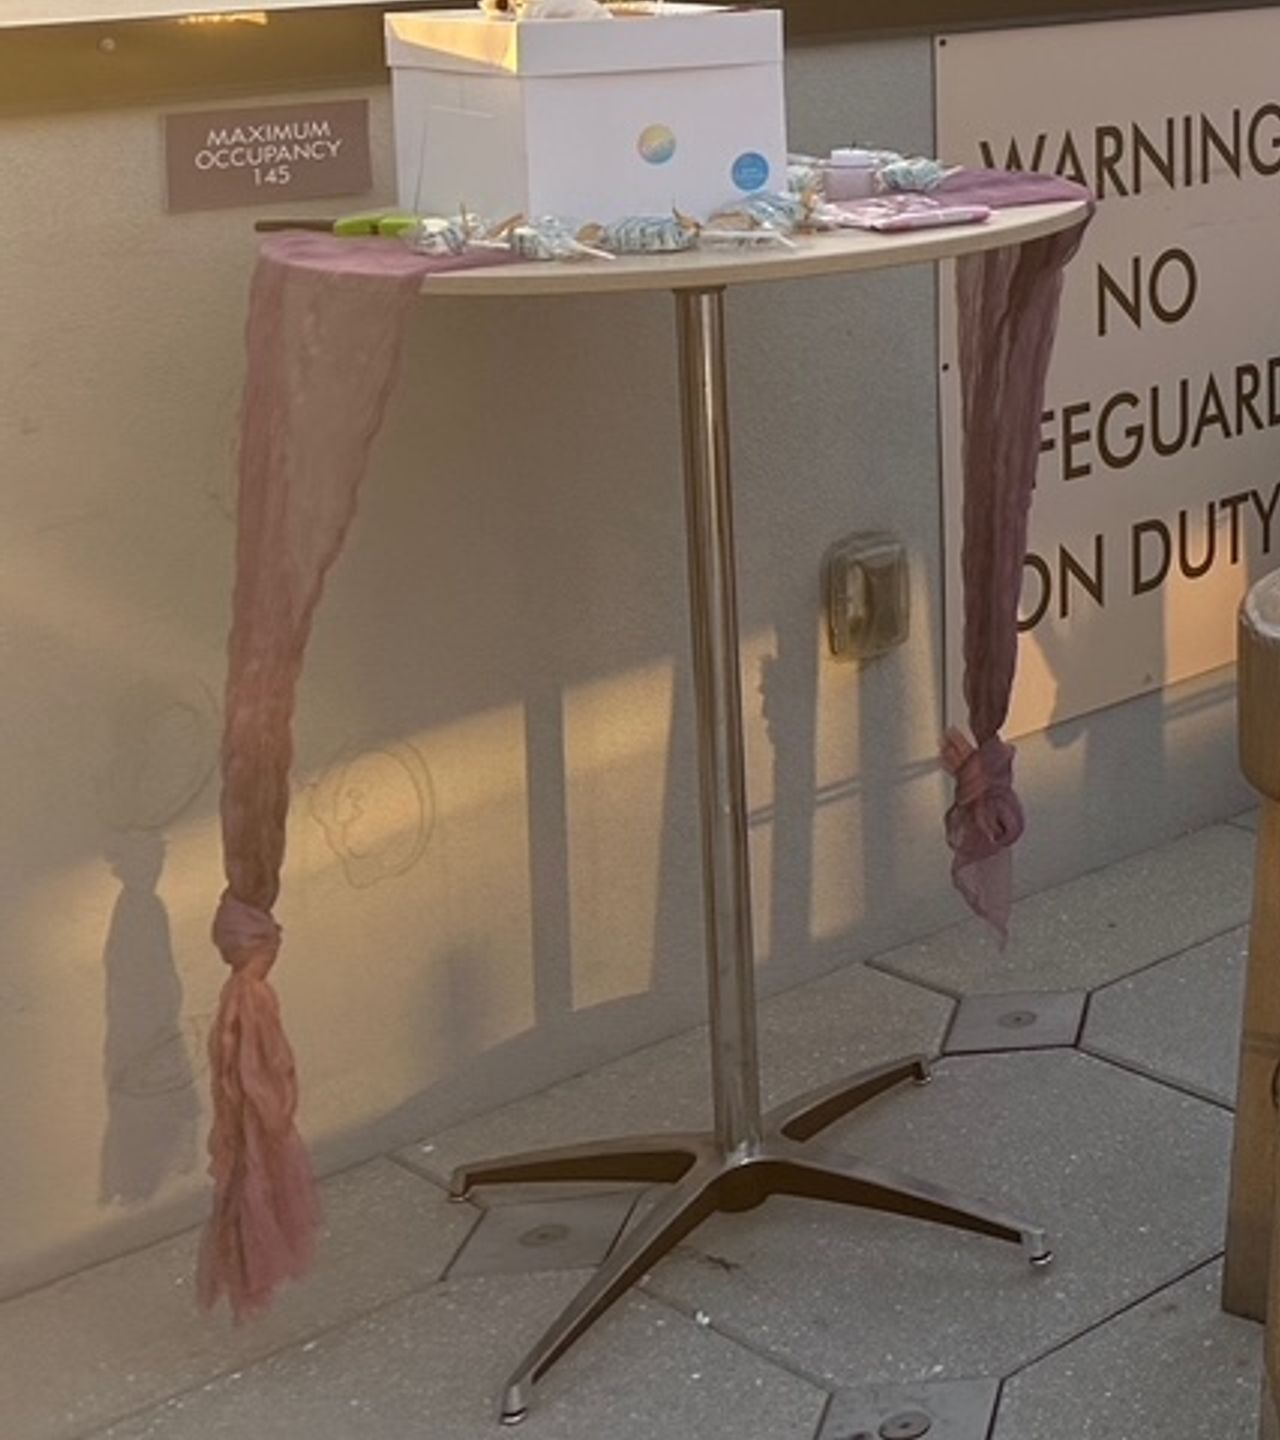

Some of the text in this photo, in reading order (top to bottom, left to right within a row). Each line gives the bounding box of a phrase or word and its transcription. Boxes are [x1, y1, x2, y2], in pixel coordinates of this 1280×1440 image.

[206, 121, 332, 147] MAXIMUM
[194, 138, 343, 170] OCCUPANCY
[253, 164, 291, 186] 145
[1098, 248, 1197, 337] NO
